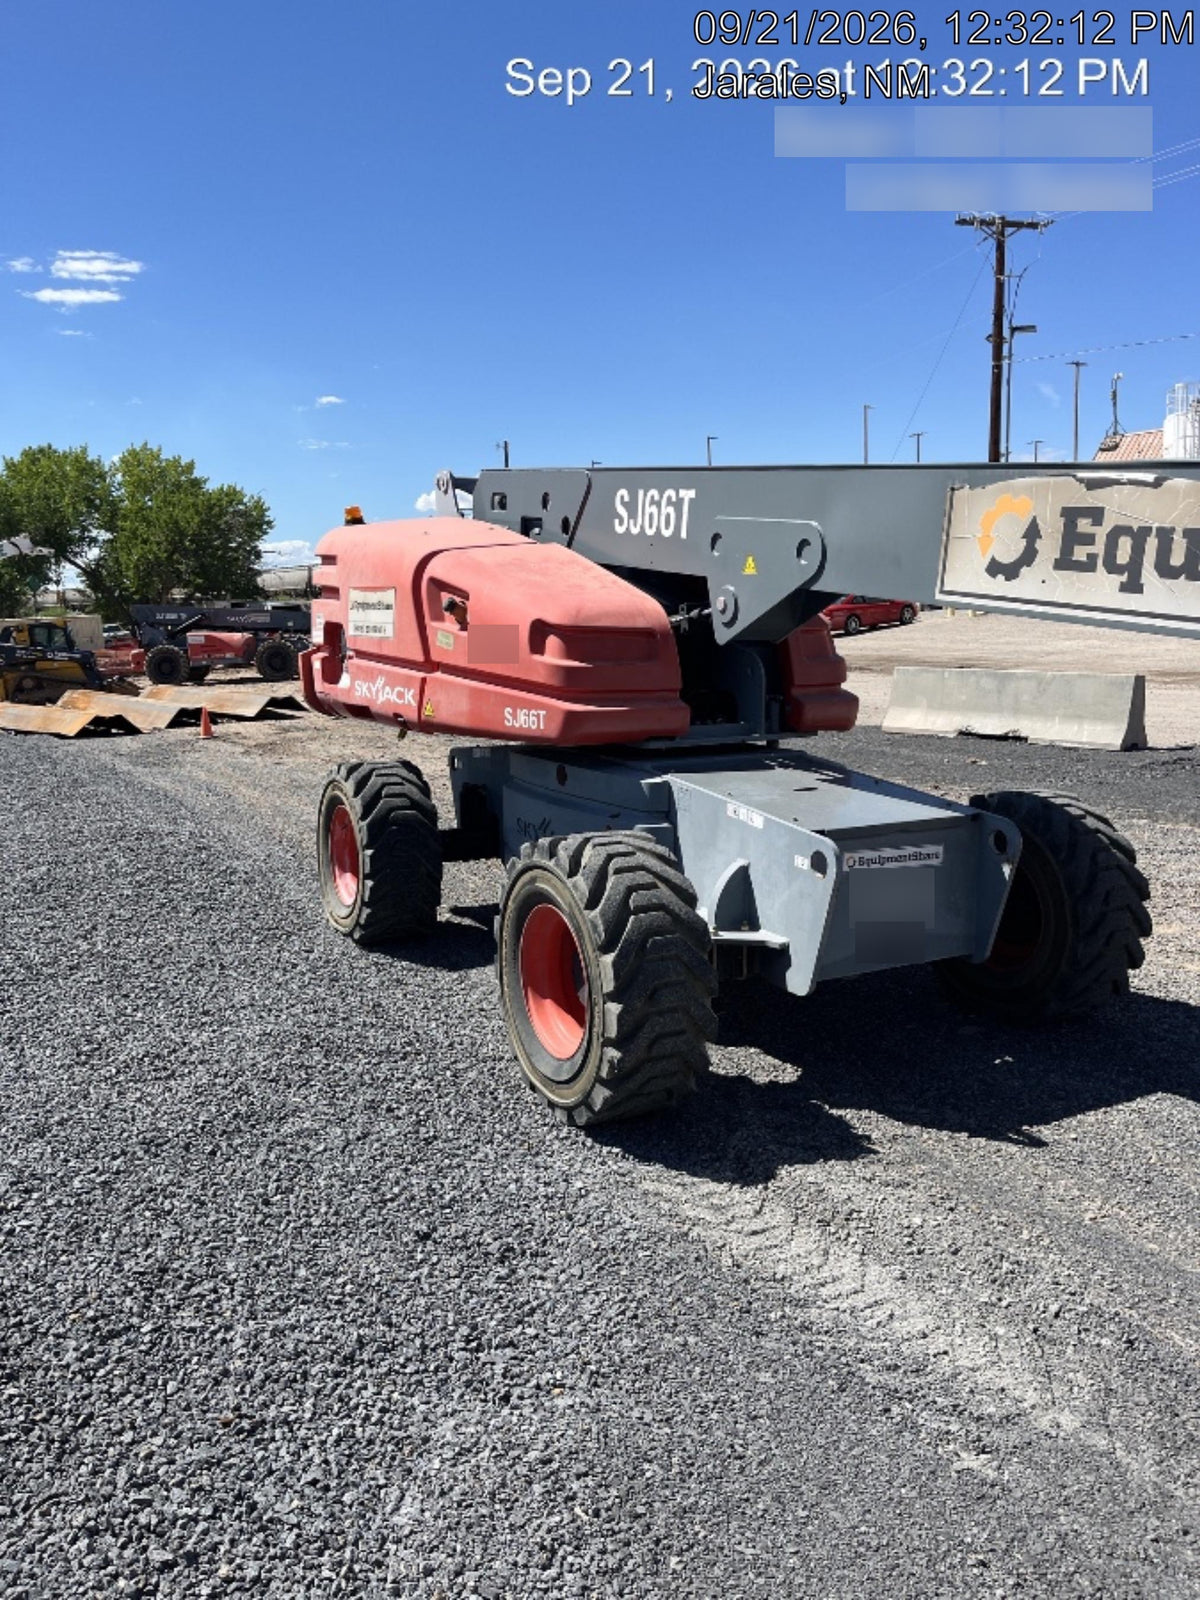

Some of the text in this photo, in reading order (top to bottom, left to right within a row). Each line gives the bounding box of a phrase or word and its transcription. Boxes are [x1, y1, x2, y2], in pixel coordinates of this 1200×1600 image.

[614, 488, 696, 539] SJ66T
[354, 674, 417, 707] SKYJACK
[504, 707, 547, 730] SJ66T
